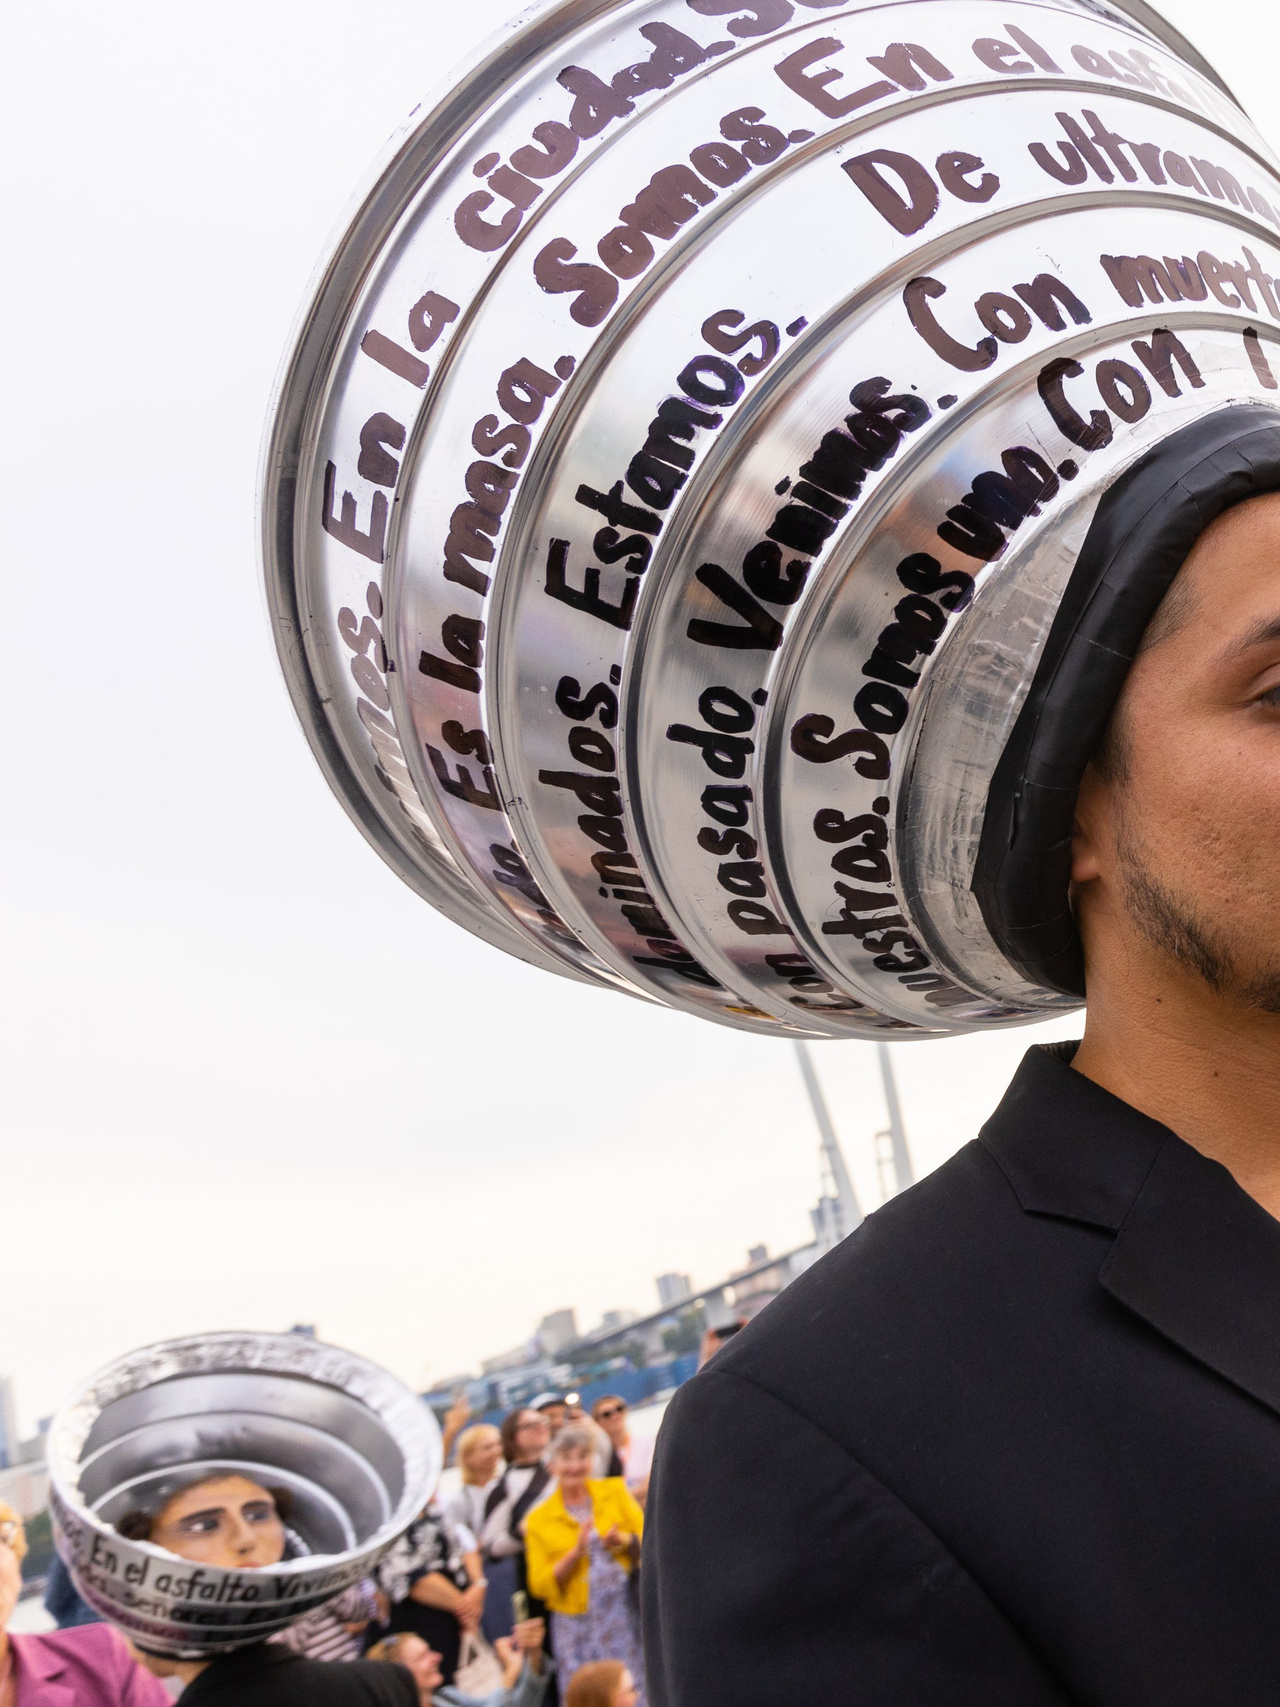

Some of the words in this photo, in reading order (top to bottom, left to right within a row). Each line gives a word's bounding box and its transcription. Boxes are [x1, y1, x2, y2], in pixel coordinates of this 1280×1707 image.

[774, 37, 955, 119] En
[971, 24, 1064, 74] el
[454, 21, 736, 252] ciudad.
[533, 107, 816, 327] Somos.
[361, 291, 460, 390] la
[544, 309, 809, 631] Estamos.
[840, 149, 1000, 238] De
[903, 273, 1093, 372] Con
[323, 412, 406, 564] En
[443, 355, 576, 598] masa.
[687, 376, 958, 651] Venimos.
[791, 552, 976, 780] Somos
[1037, 328, 1205, 450] Con
[418, 613, 485, 693] la
[424, 719, 507, 813] Es
[666, 686, 796, 936] pasado.
[90, 1535, 117, 1573] En
[124, 1557, 149, 1586] el
